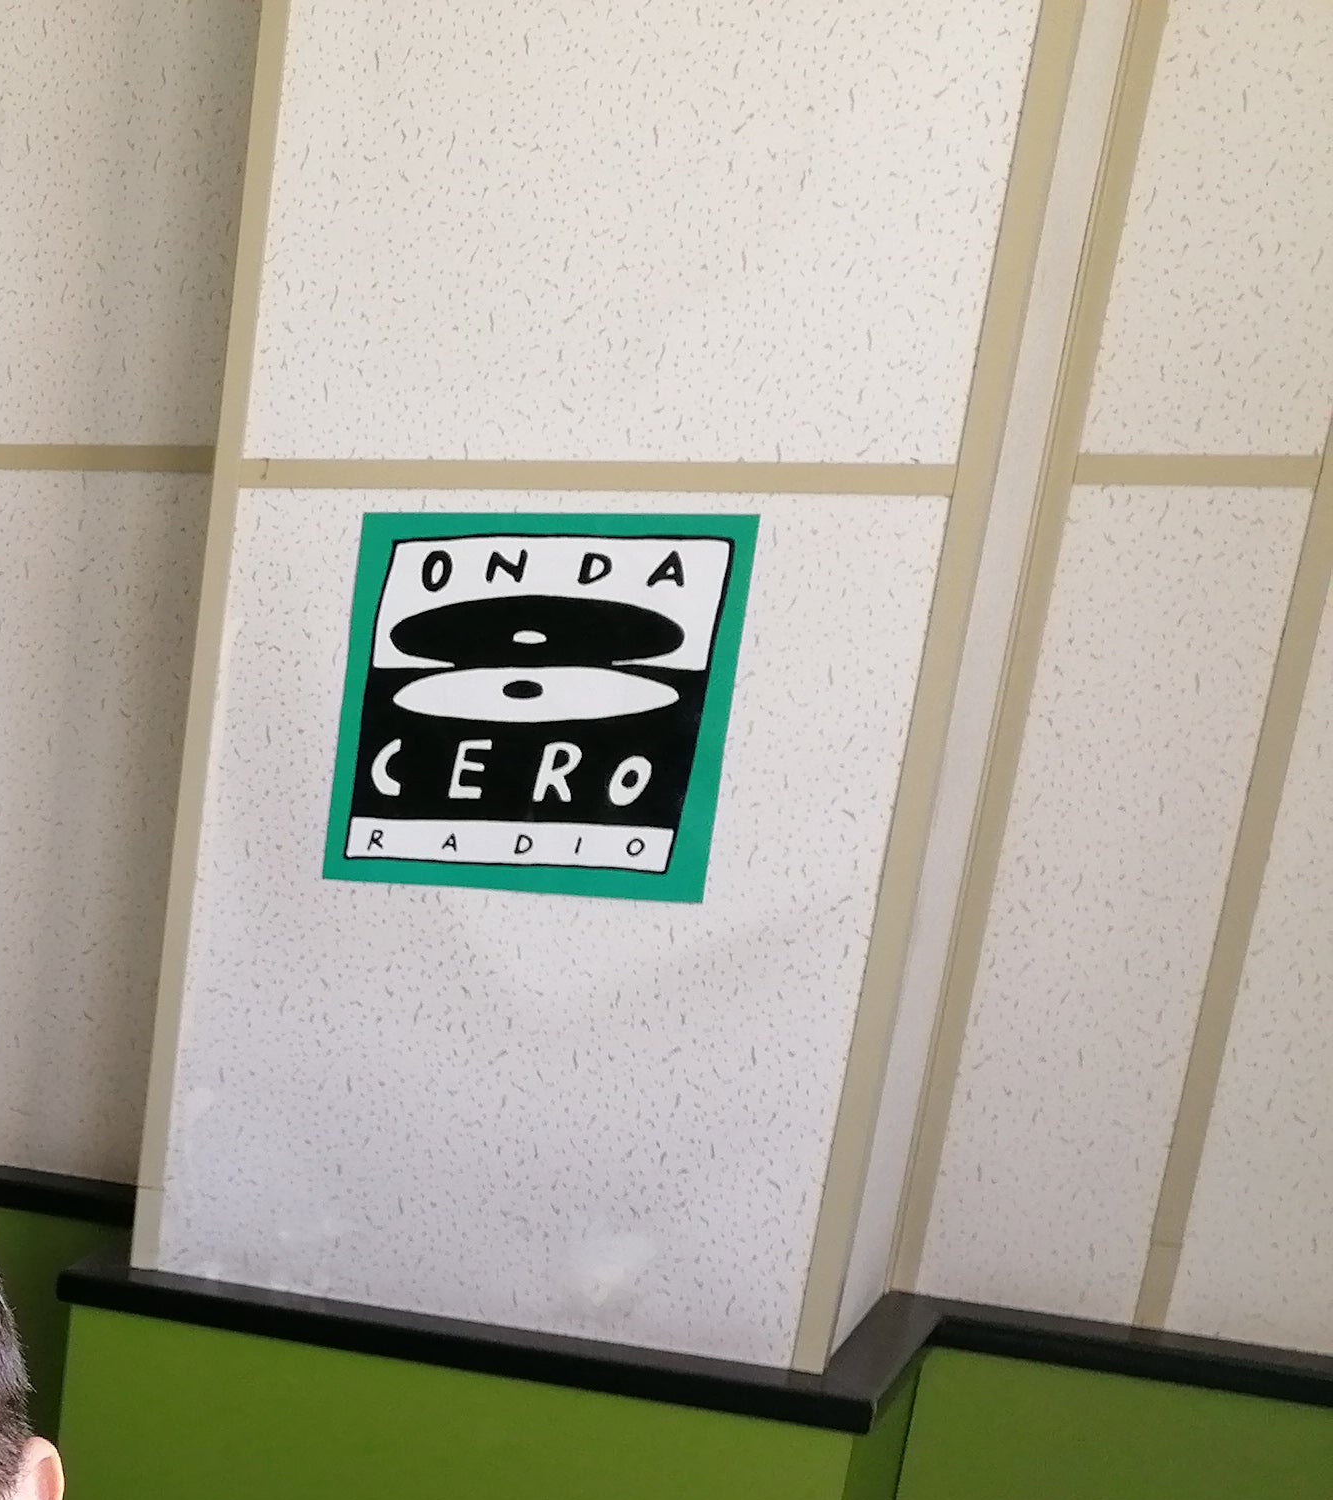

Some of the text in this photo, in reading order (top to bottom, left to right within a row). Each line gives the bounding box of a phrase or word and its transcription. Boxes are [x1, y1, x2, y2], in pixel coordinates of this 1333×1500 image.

[421, 549, 685, 592] ONDA
[371, 739, 653, 807] CERO
[367, 829, 646, 856] RADIO
